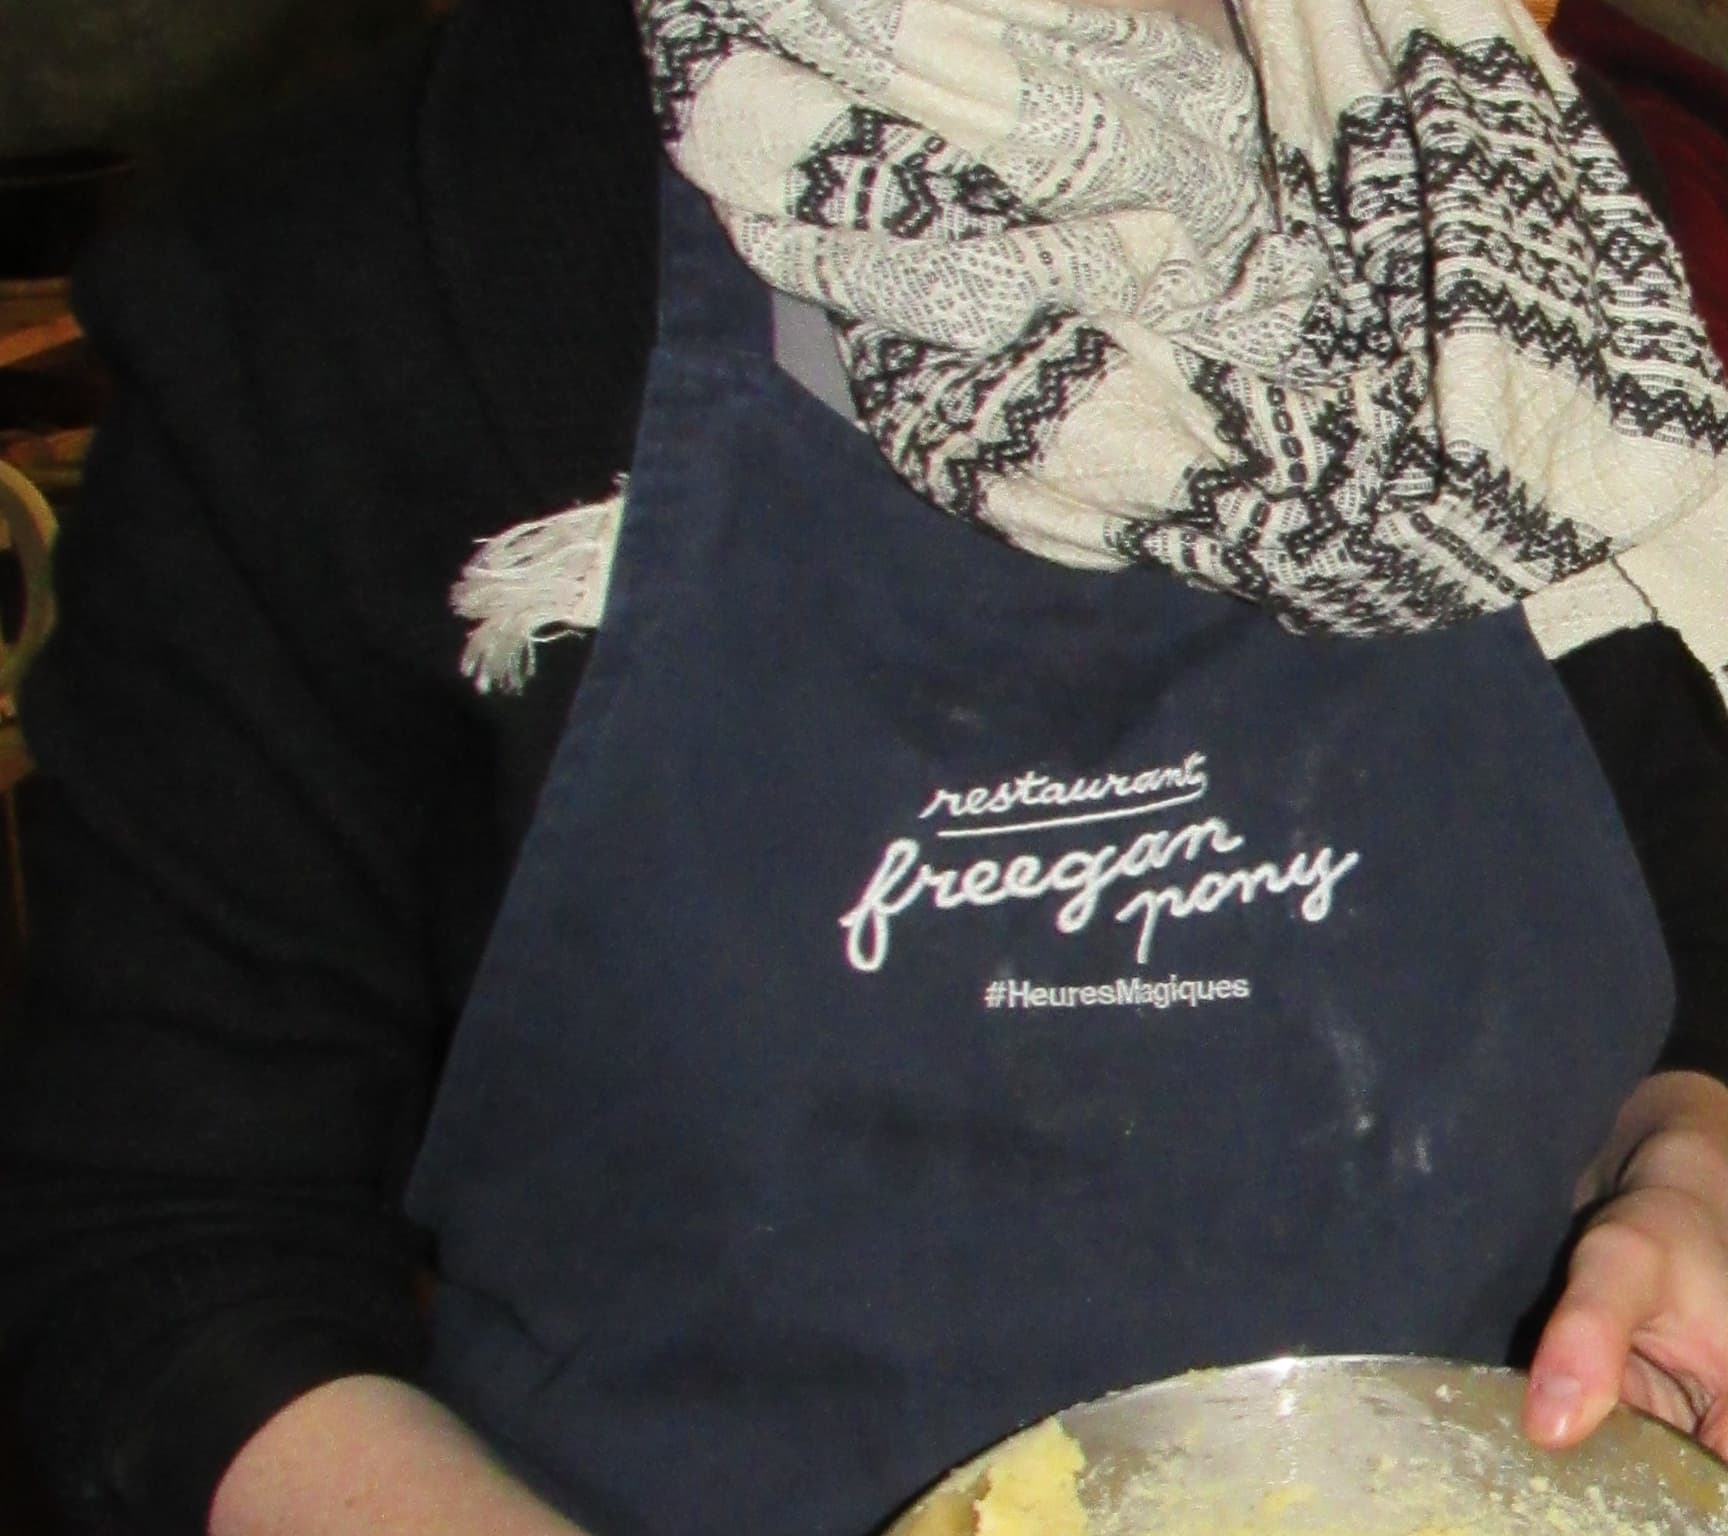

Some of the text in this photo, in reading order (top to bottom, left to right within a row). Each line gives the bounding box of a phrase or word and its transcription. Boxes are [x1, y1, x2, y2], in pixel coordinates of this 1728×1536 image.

[919, 751, 1206, 819] restaurant
[838, 814, 1360, 973] freegan pony
[983, 973, 1252, 1011] #HeuresMagiques
